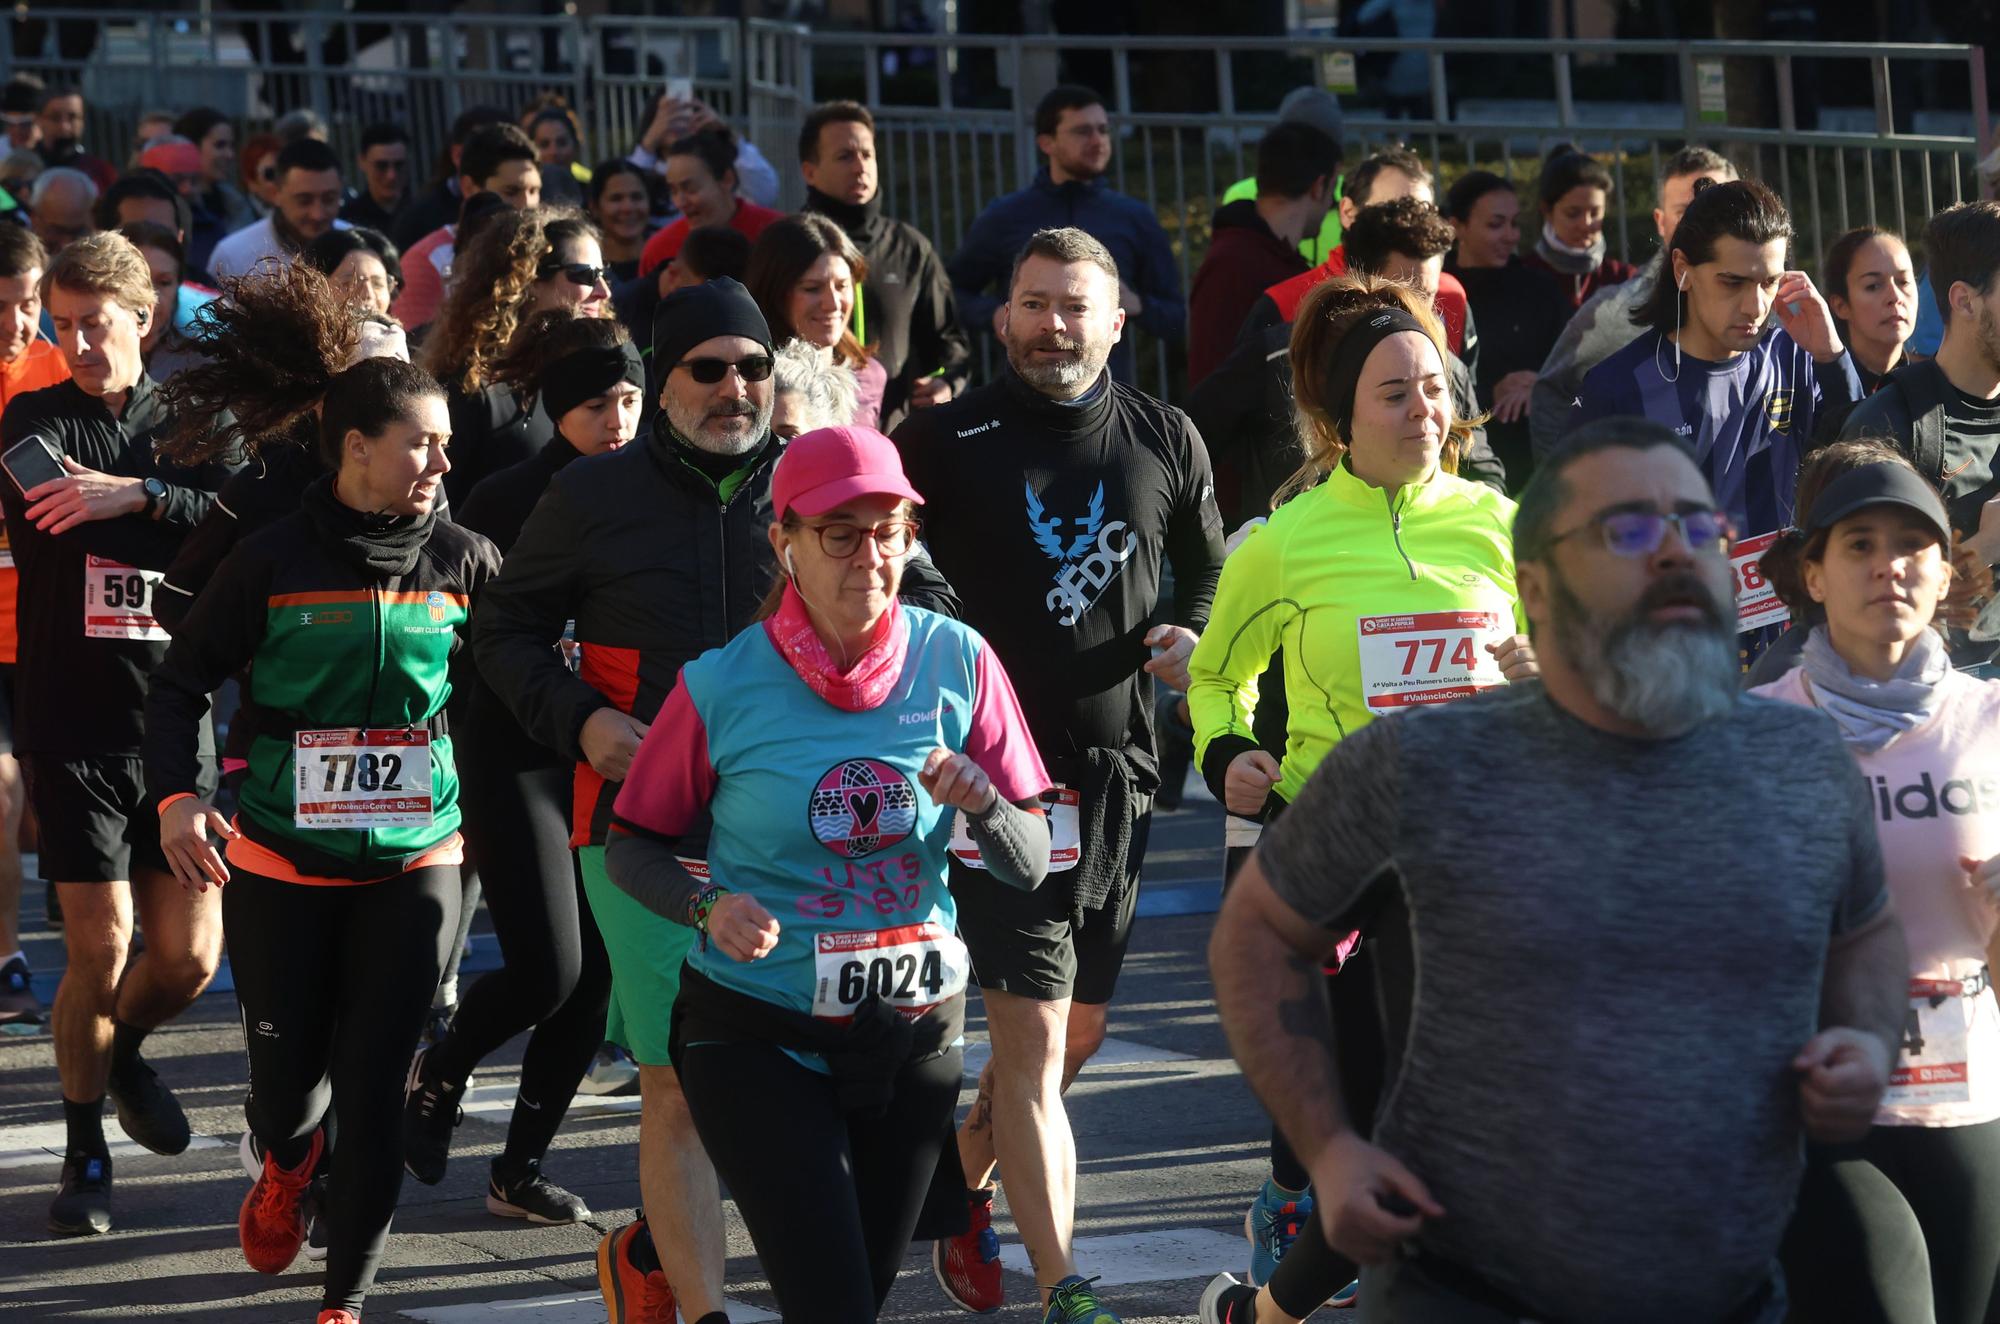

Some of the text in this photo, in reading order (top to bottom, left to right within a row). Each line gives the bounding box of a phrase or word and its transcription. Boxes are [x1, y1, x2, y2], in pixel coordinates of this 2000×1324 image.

[957, 422, 990, 438] luanvi
[1046, 520, 1137, 627] 3FDC
[1395, 637, 1478, 676] 774
[1403, 690, 1471, 702] #ValènciaCorre
[898, 708, 943, 725] FLOWE
[320, 753, 403, 792] 7782
[331, 801, 392, 811] #ValènciaCorre
[838, 950, 944, 1005] 6024
